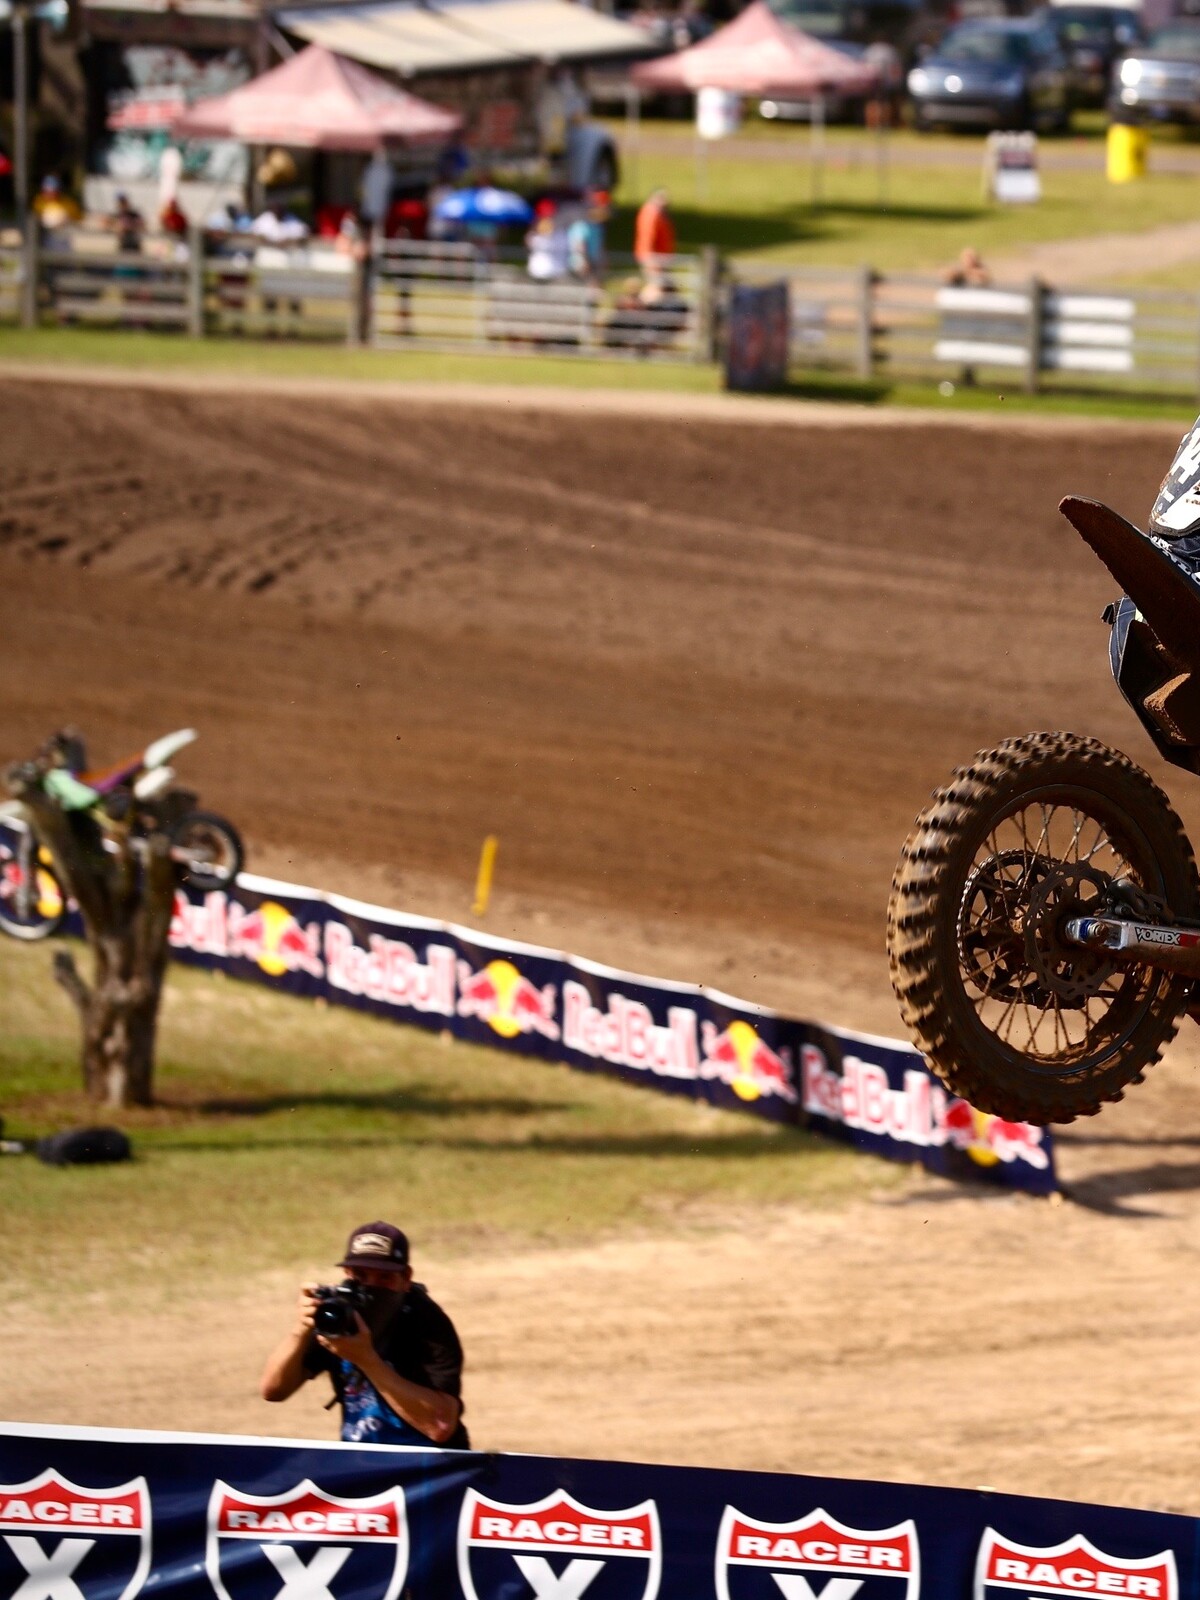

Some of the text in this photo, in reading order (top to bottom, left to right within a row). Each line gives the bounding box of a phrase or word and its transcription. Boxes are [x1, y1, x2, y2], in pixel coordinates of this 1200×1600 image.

[1134, 926, 1181, 946] VORTEX
[0, 1499, 135, 1526] ACER
[225, 1509, 391, 1535] RACER
[478, 1516, 645, 1548] RACER
[1, 1535, 98, 1600] X
[737, 1535, 904, 1568] RACER
[259, 1544, 354, 1600] X
[994, 1557, 1162, 1598] RACER
